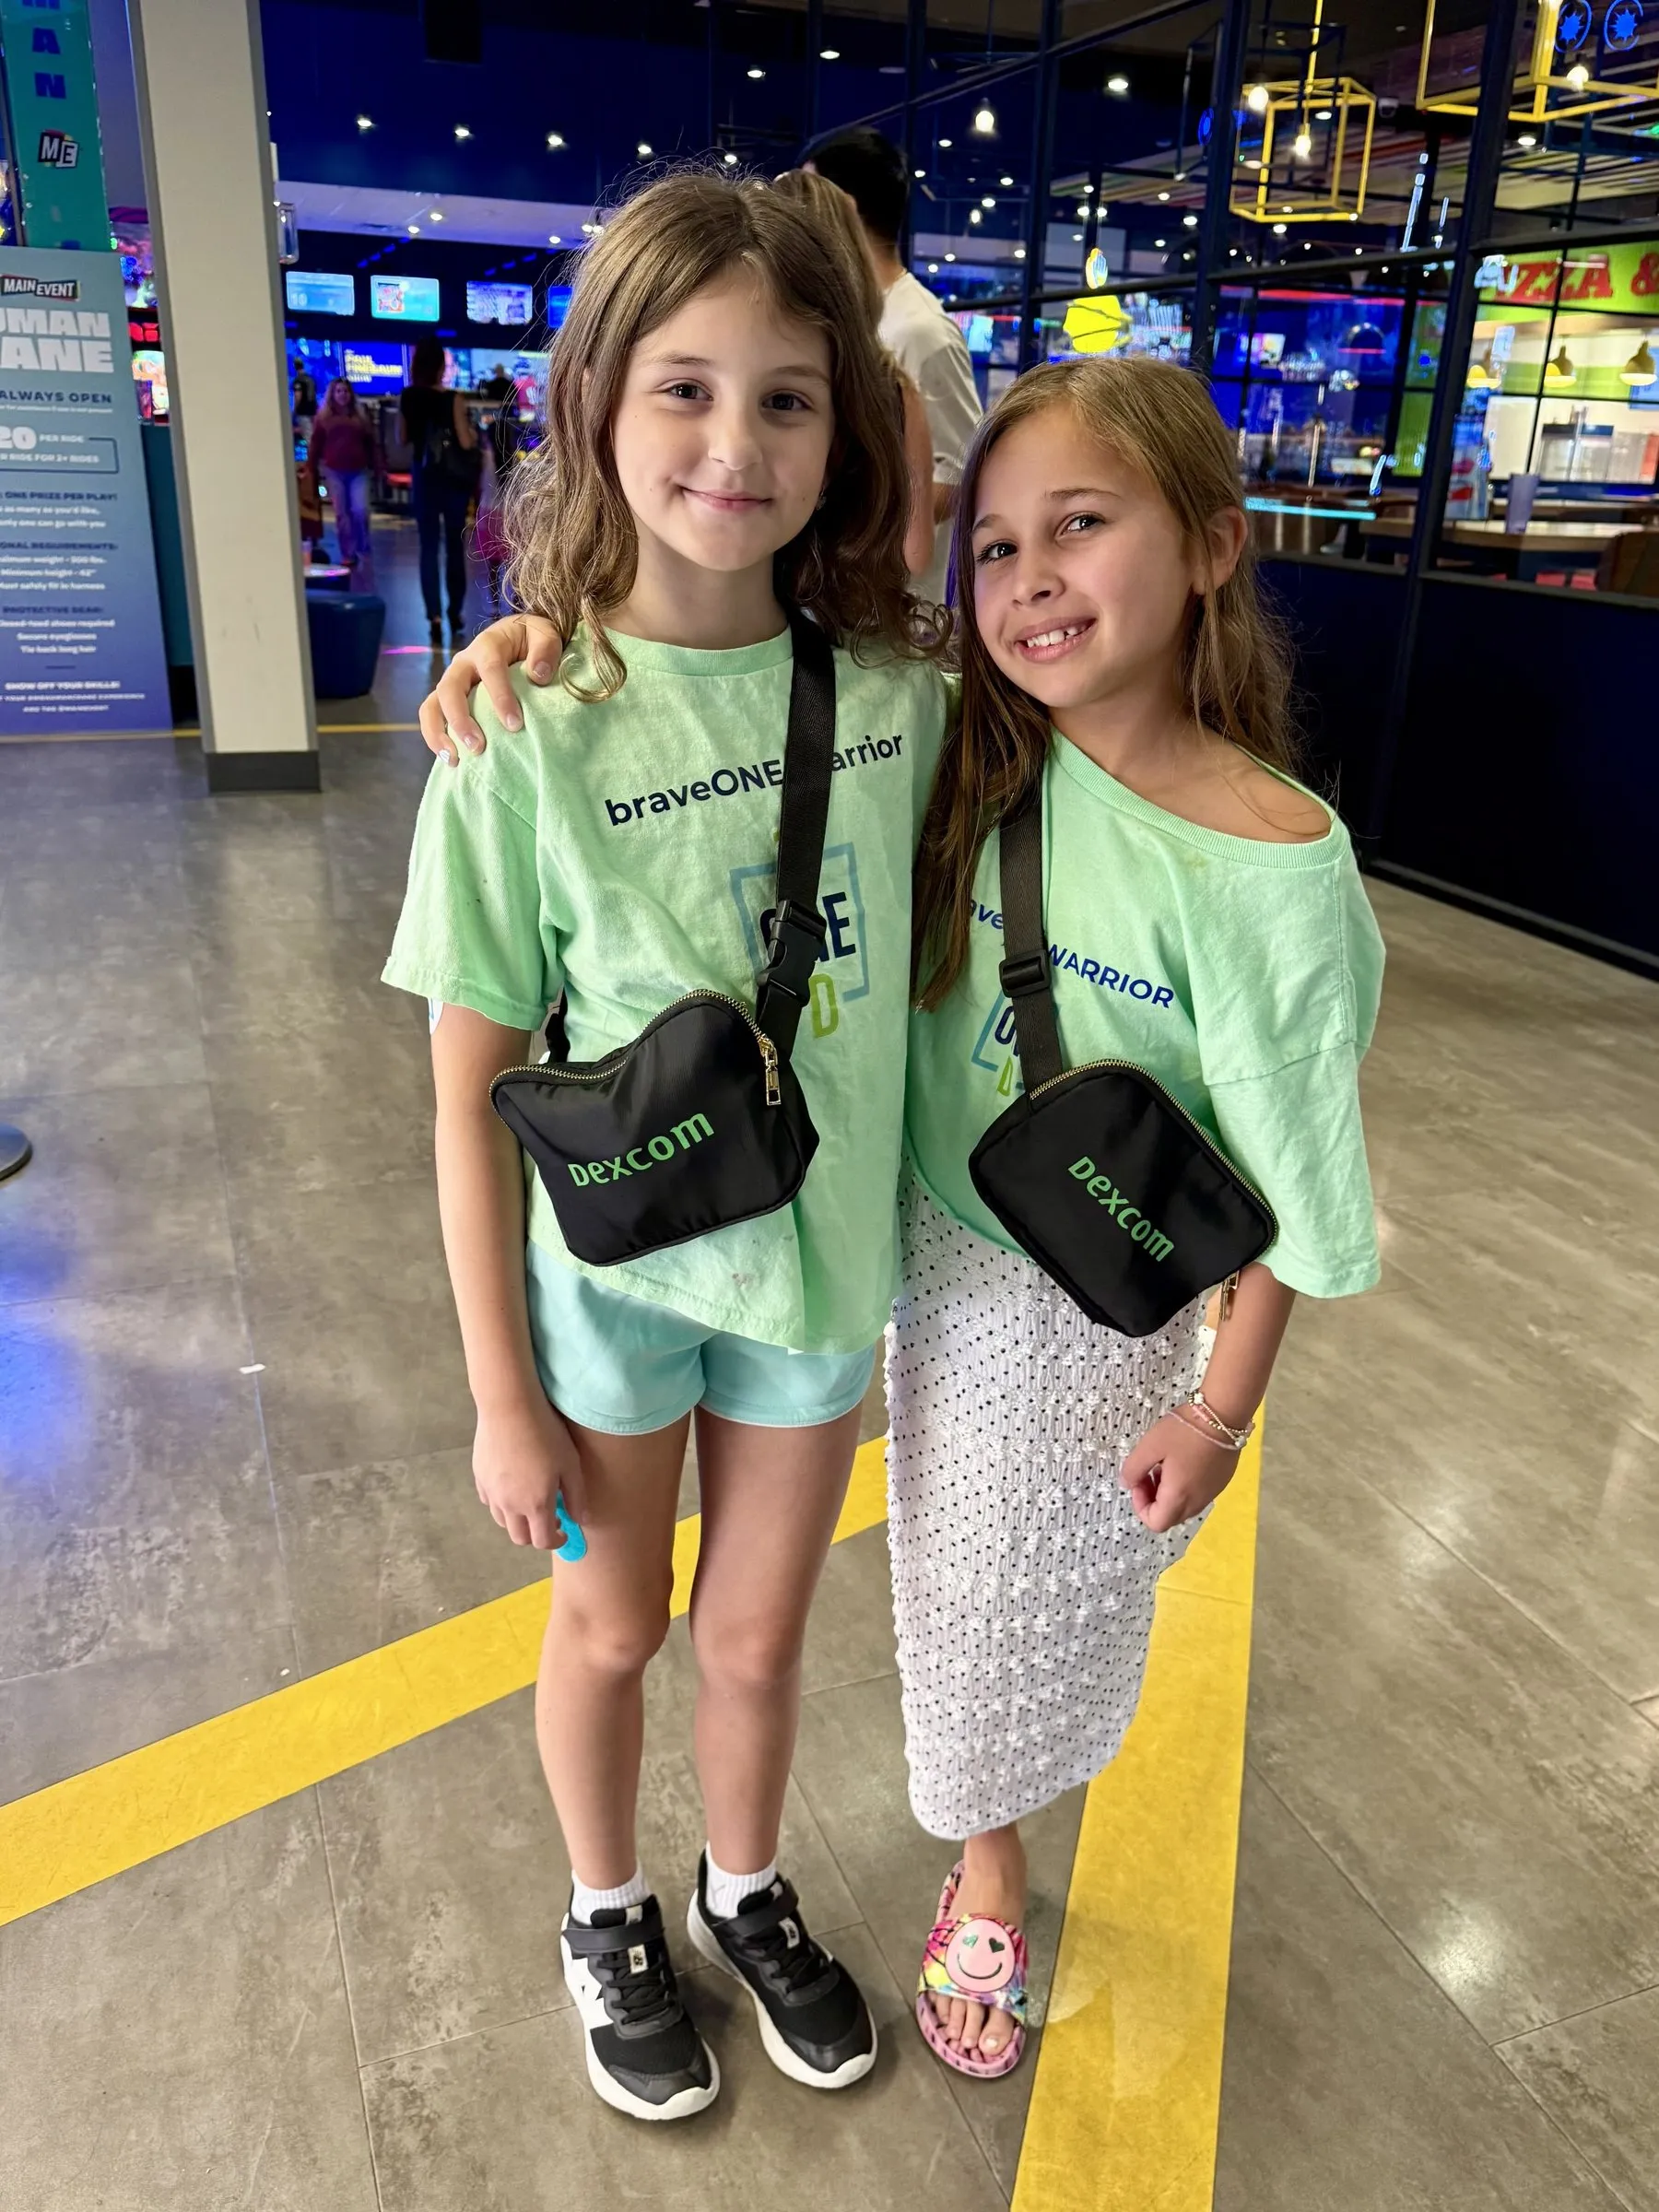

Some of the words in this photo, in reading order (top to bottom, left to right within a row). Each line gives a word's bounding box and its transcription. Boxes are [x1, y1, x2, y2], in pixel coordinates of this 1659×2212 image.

[4, 278, 36, 293] MAIN
[37, 283, 76, 297] EVENT
[68, 393, 112, 403] OPEN
[605, 759, 783, 826] braveONE
[830, 735, 902, 771] arrior
[568, 1112, 715, 1187] Dexcom
[1067, 1156, 1175, 1262] Dexcom
